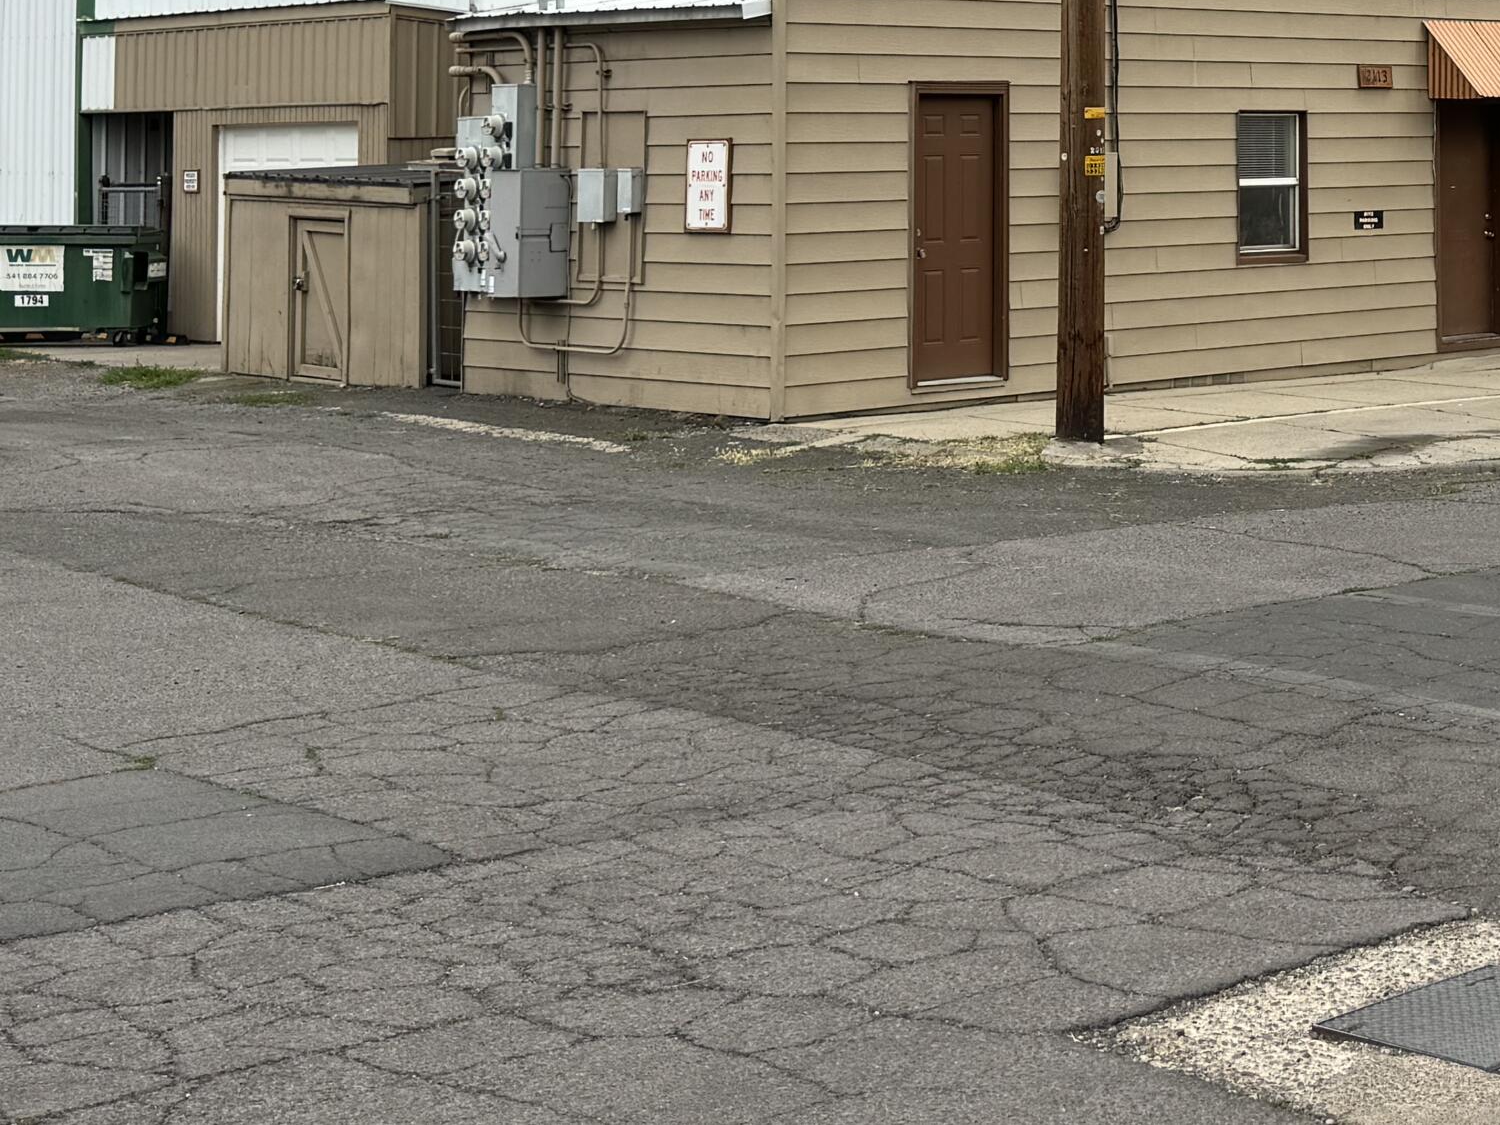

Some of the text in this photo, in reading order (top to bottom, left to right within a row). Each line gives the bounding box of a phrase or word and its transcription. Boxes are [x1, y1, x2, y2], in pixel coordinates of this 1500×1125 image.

[701, 151, 714, 163] NO
[691, 170, 723, 182] PARKING
[699, 189, 714, 202] ANY
[698, 208, 715, 221] TIME
[6, 248, 57, 263] WM
[20, 295, 44, 305] 1794
